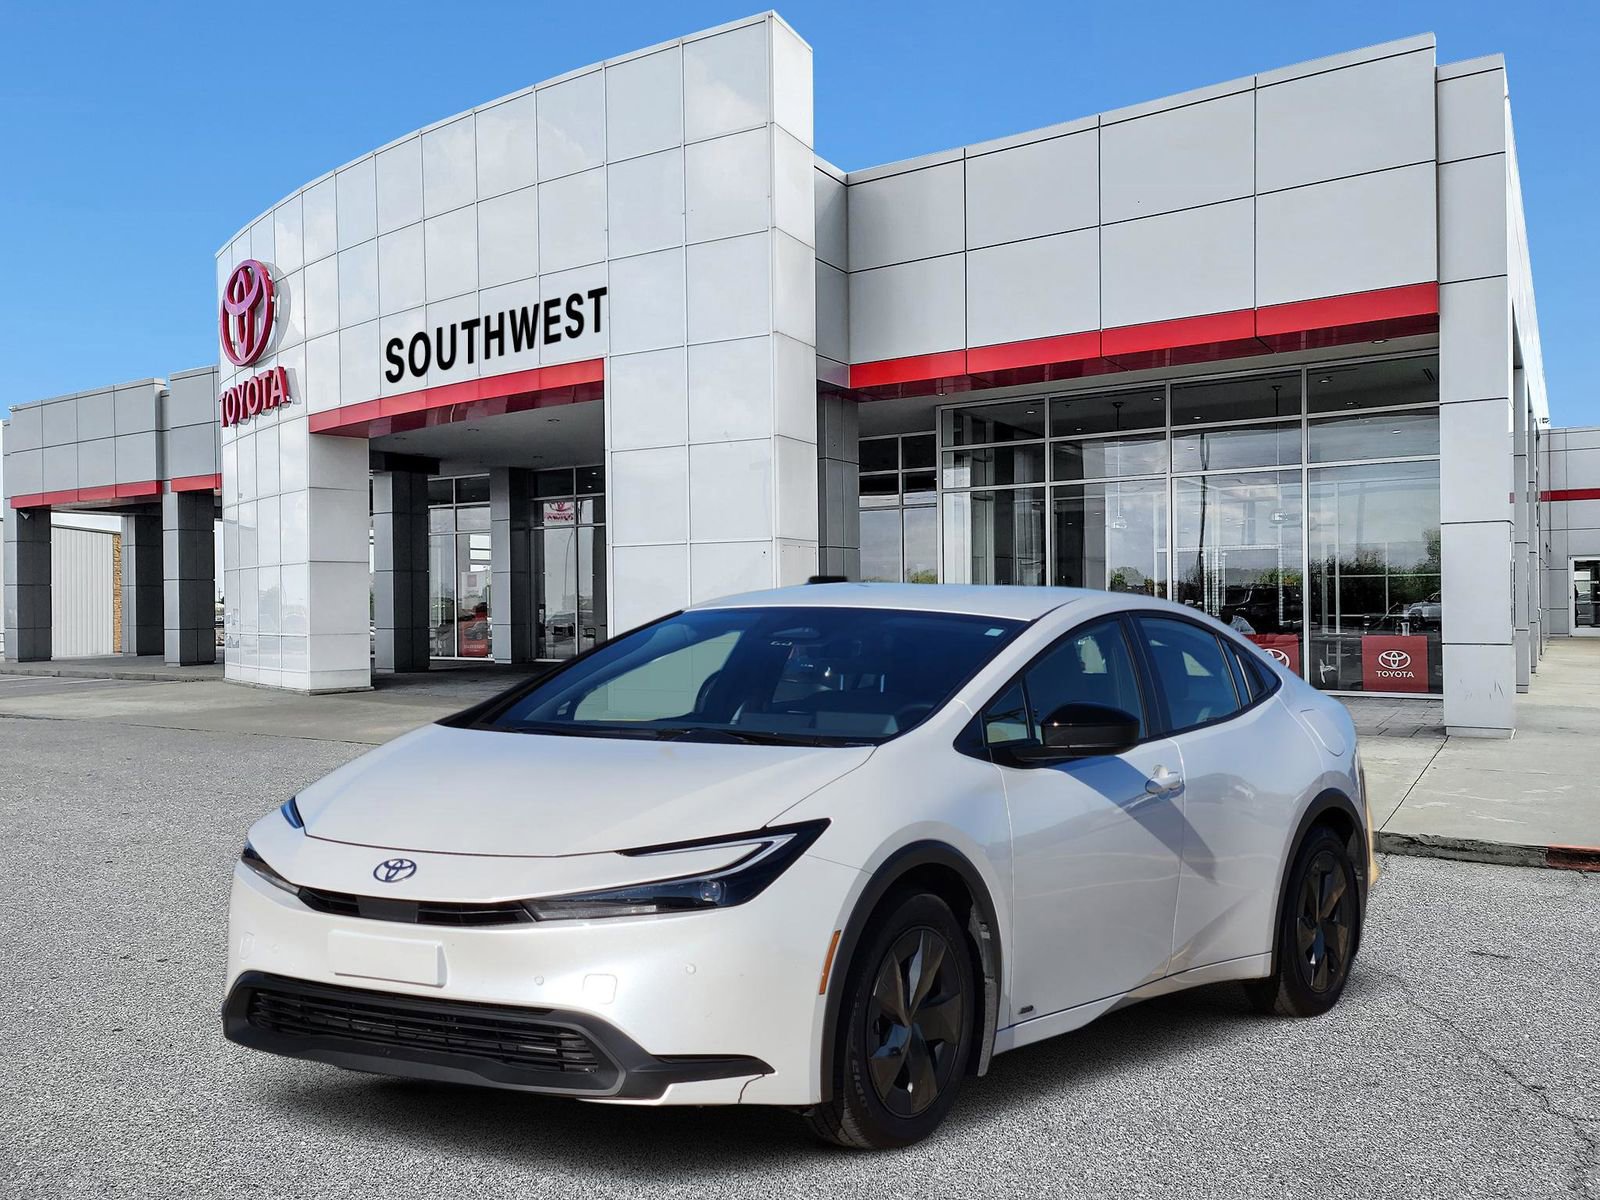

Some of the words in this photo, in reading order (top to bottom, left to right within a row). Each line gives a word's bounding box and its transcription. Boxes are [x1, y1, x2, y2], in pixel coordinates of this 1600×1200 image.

[385, 286, 608, 384] SOUTHWEST
[218, 366, 290, 427] TOYOTA
[1375, 670, 1415, 678] TOYOTA
